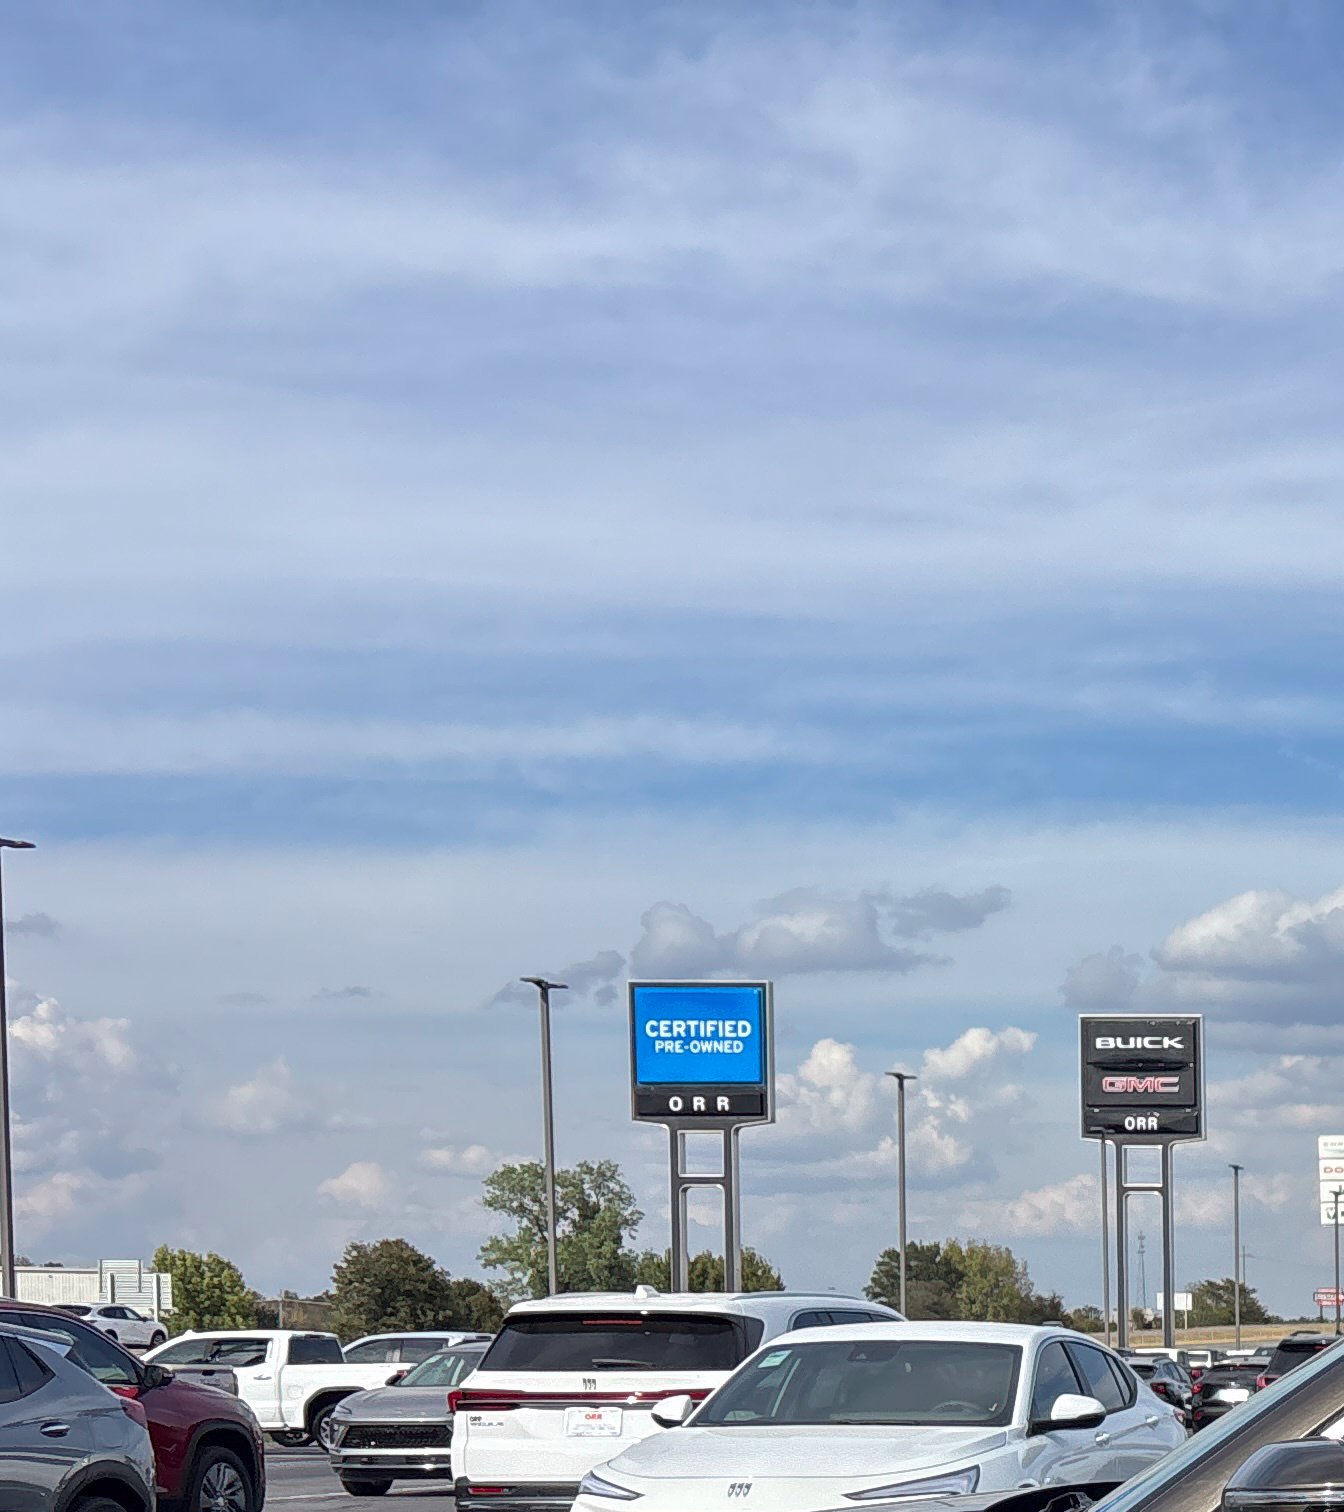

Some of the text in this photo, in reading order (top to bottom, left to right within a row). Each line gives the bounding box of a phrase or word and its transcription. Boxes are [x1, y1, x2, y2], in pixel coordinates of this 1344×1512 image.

[645, 1020, 752, 1038] CERTIFIED
[655, 1040, 744, 1054] PRE-OWNED
[1095, 1036, 1185, 1049] BUICK
[1102, 1076, 1180, 1093] GMC
[668, 1096, 730, 1112] ORR
[1124, 1116, 1158, 1131] ORR
